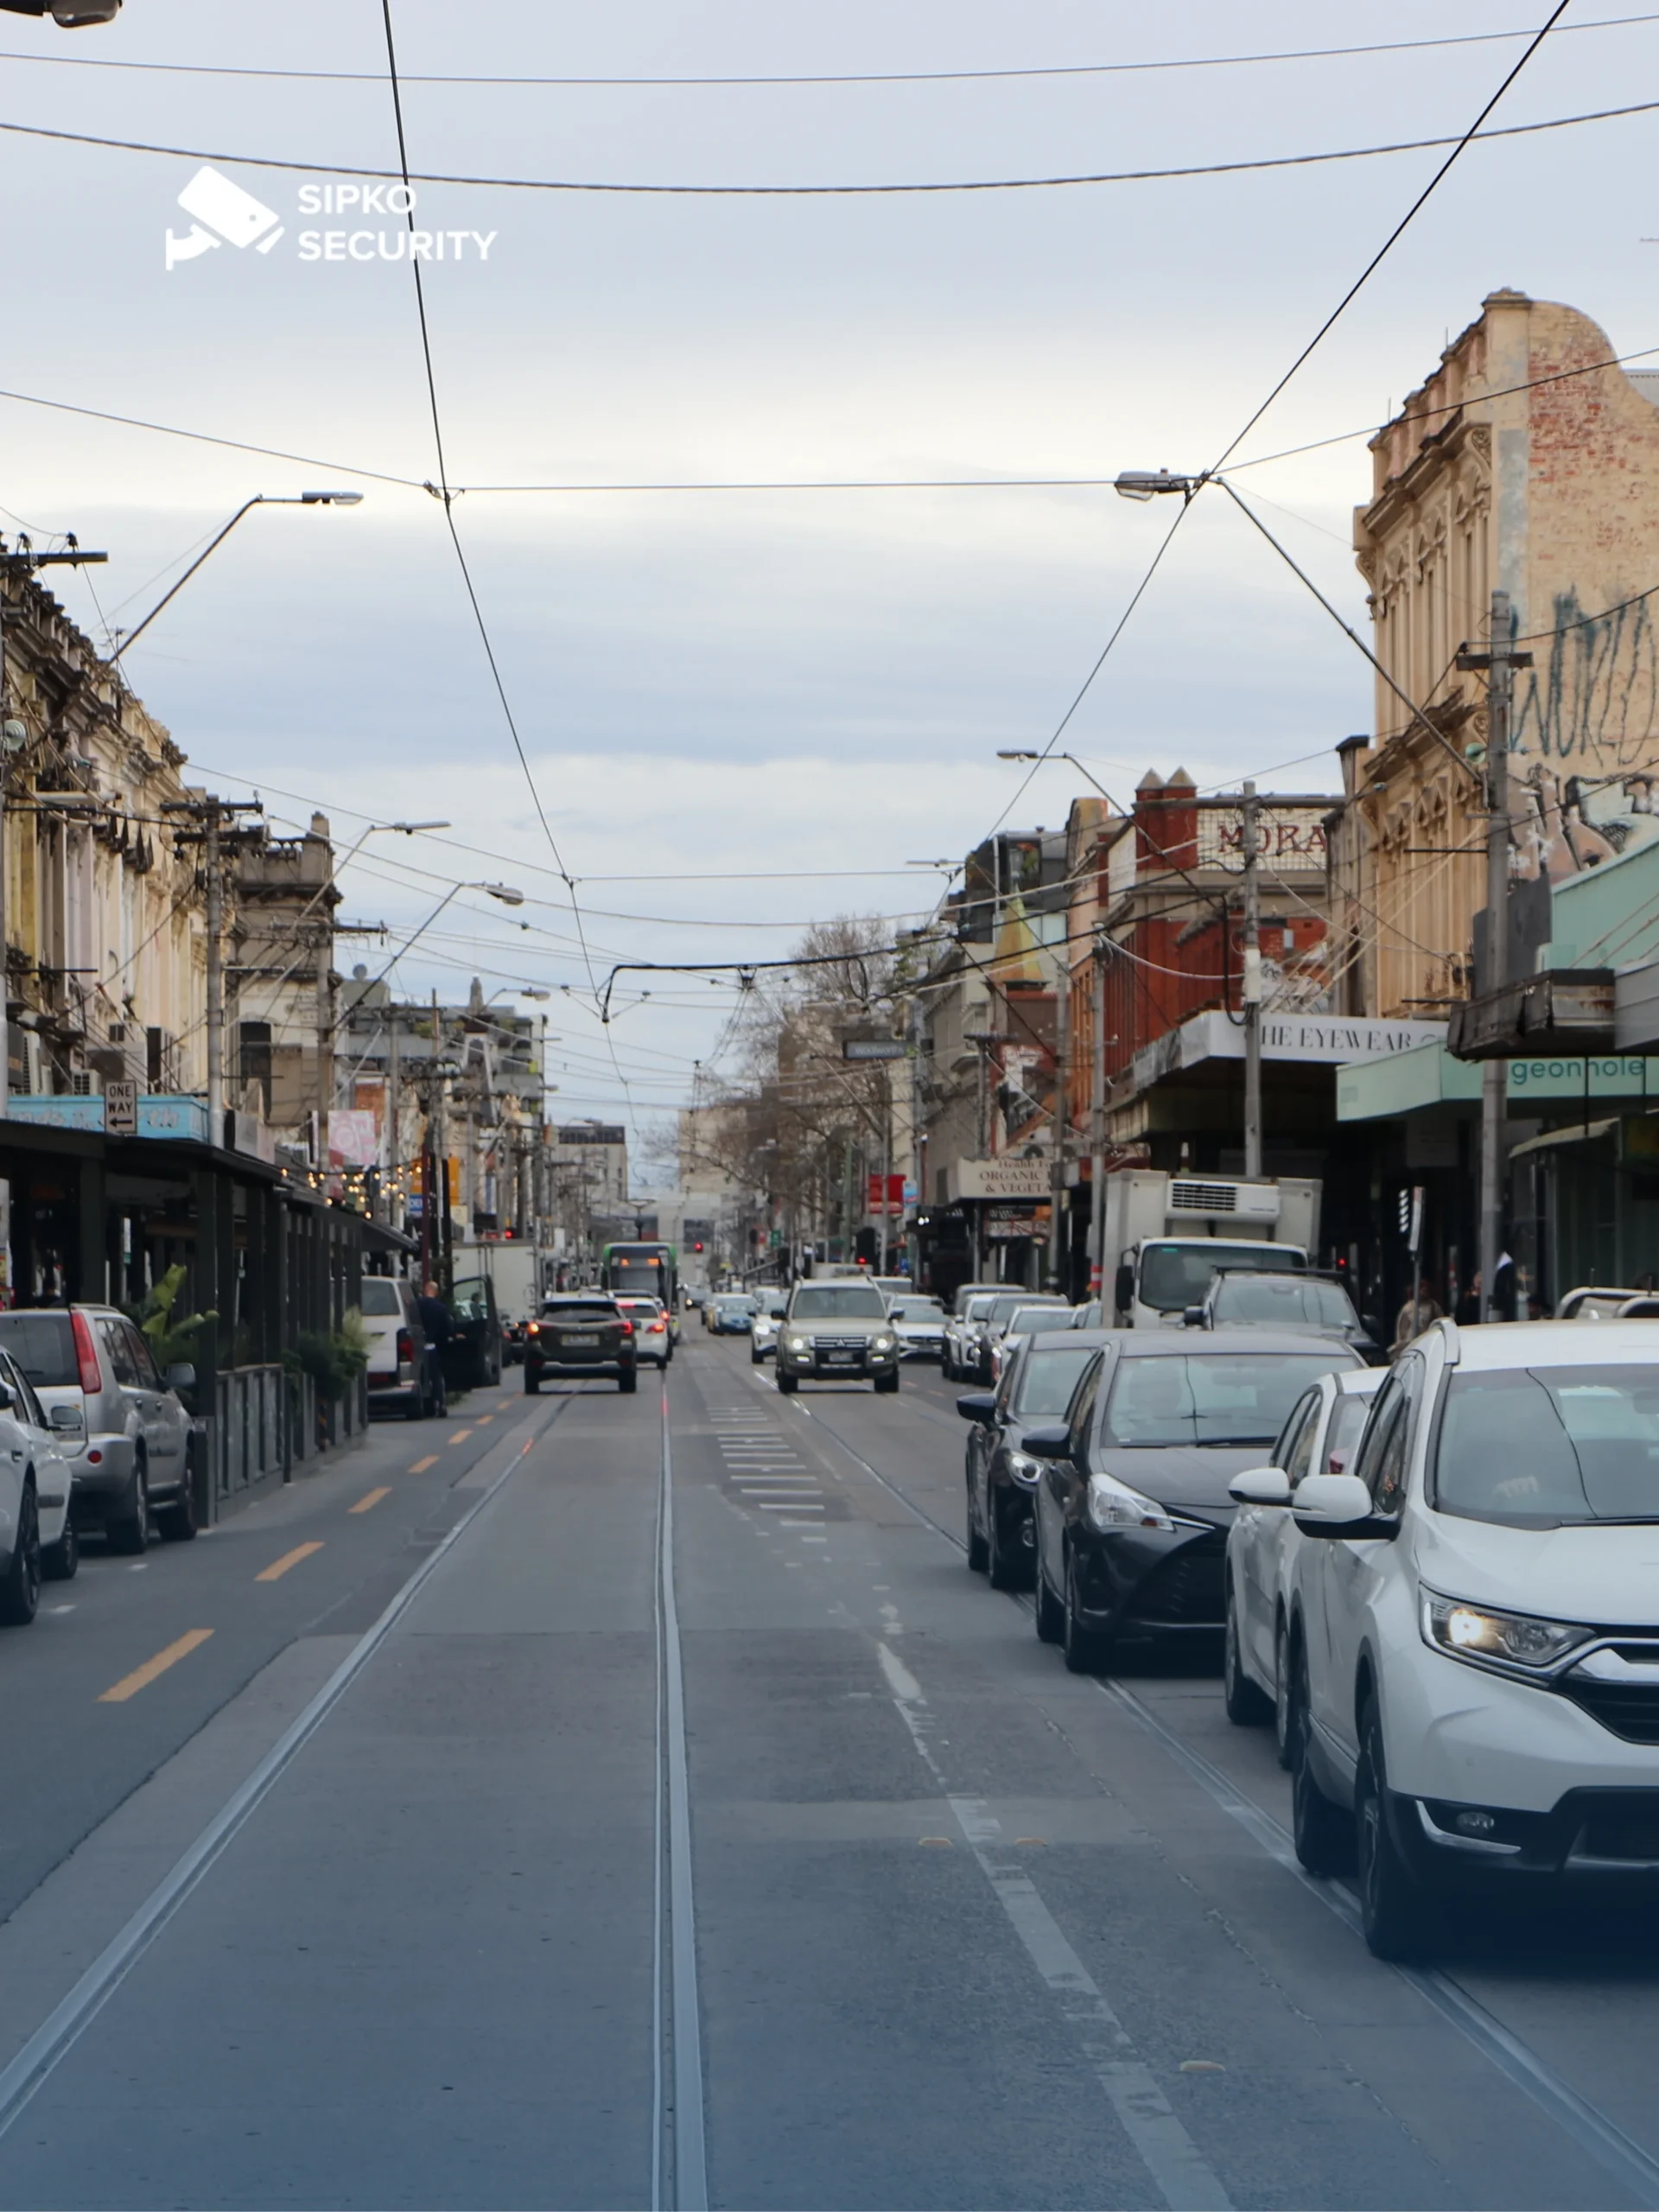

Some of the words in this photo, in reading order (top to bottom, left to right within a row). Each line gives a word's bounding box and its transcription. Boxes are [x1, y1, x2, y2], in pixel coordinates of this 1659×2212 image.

[1251, 1025, 1293, 1047] HE
[1299, 1027, 1412, 1052] EYEWEAR
[109, 1084, 132, 1098] ONE
[107, 1102, 133, 1115] WAY
[979, 1171, 1042, 1180] ORGANIC
